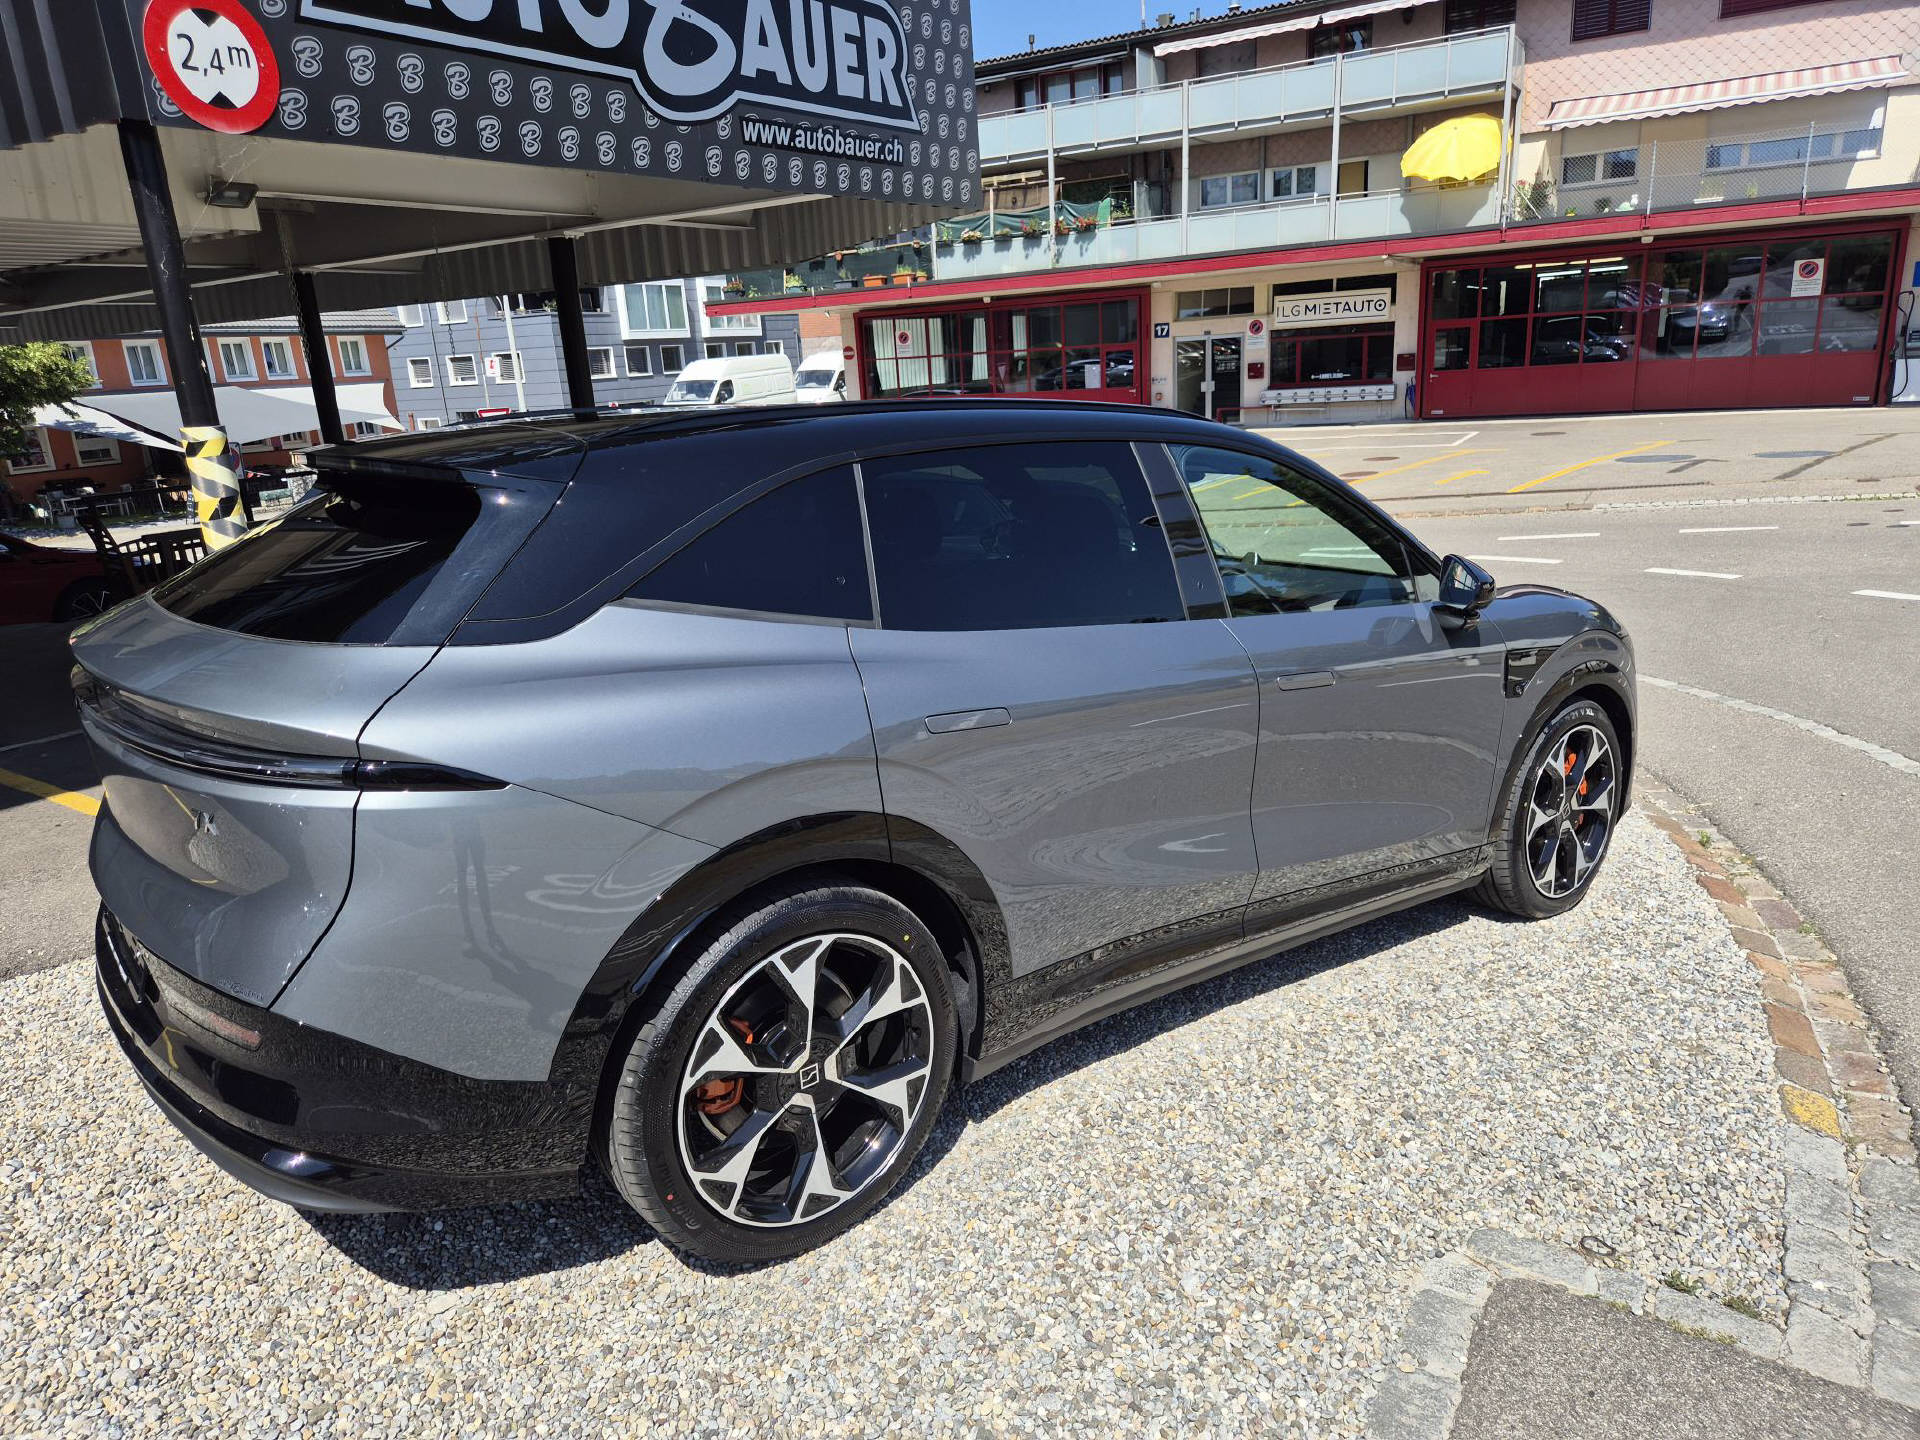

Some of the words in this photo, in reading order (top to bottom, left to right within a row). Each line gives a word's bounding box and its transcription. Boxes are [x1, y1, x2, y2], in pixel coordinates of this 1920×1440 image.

[742, 120, 904, 163] www.autobauer.ch
[1276, 305, 1301, 319] ILG
[1304, 298, 1387, 316] MIETAUTO
[1155, 325, 1169, 337] 17
